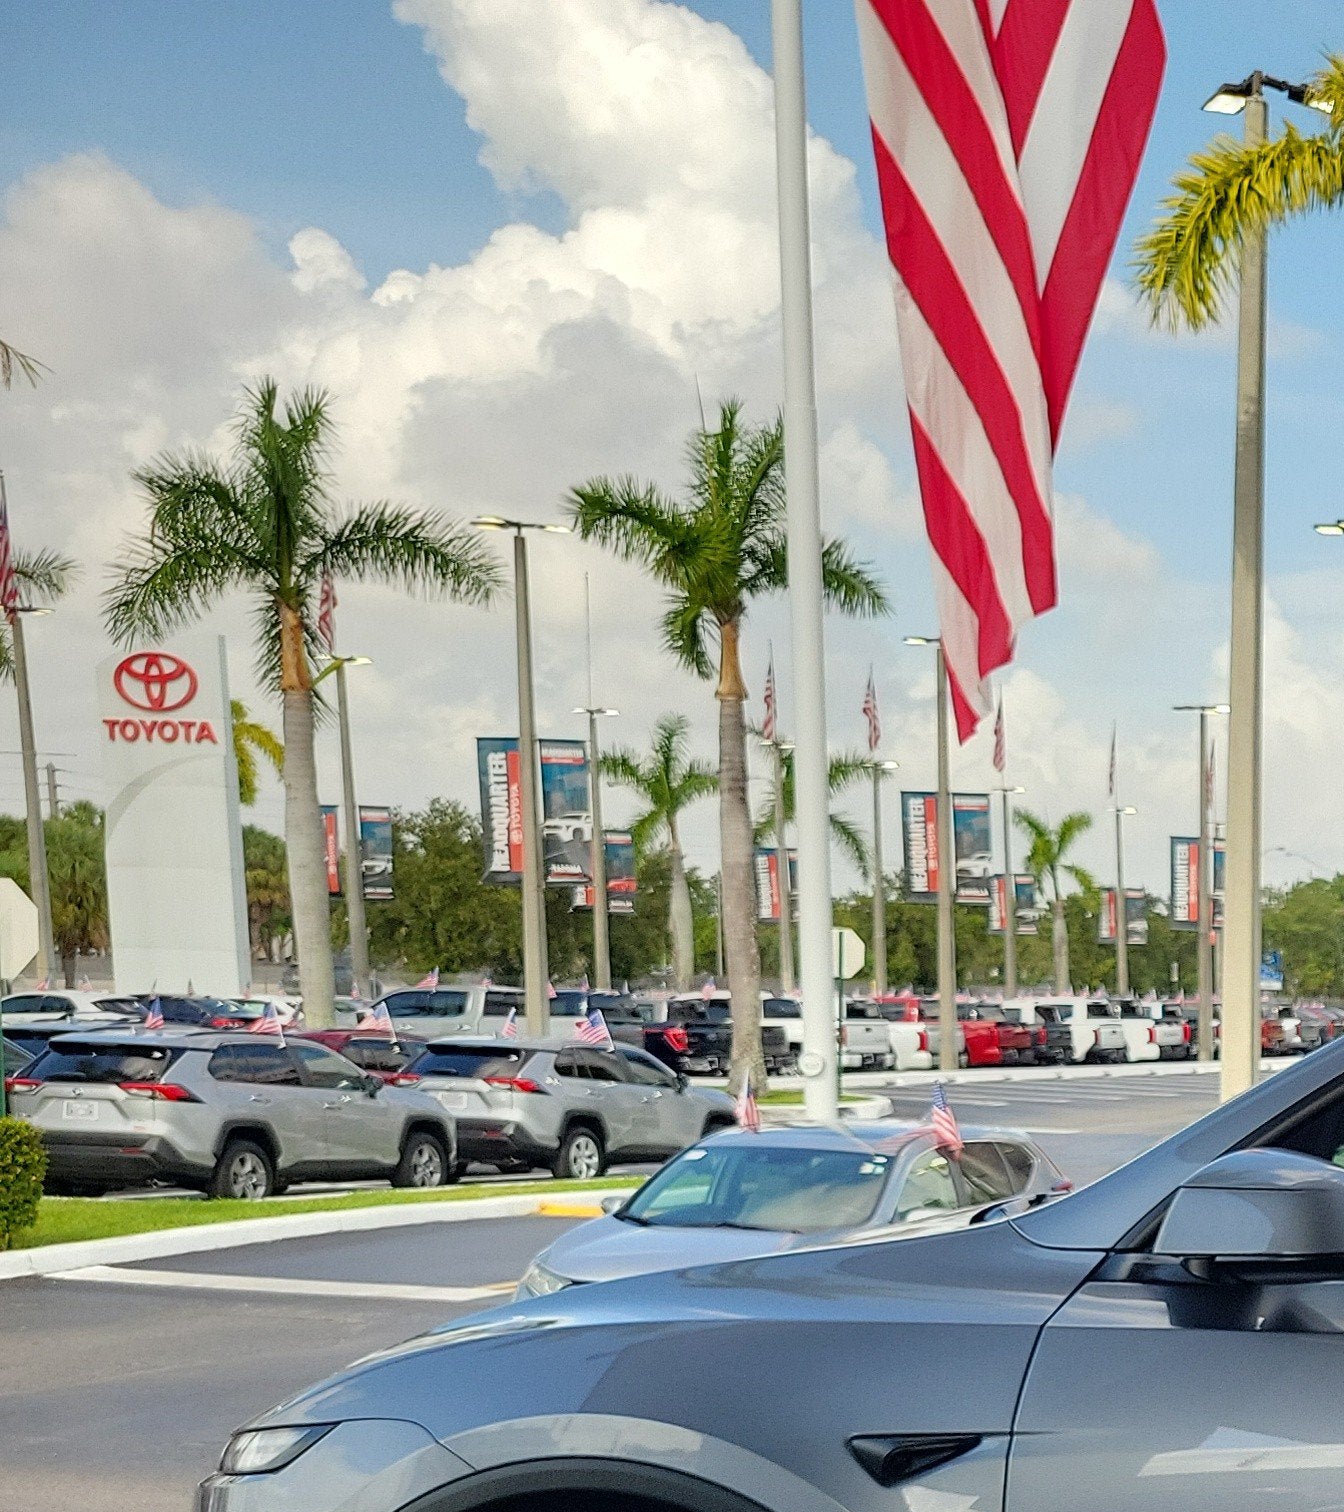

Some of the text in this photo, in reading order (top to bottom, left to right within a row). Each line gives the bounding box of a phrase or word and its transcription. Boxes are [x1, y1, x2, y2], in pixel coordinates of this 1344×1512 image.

[103, 718, 218, 744] TOYOTA
[487, 752, 511, 872] HEADQUARTER
[509, 782, 522, 828] TOYOTA
[909, 798, 928, 892] HEADQUARTER
